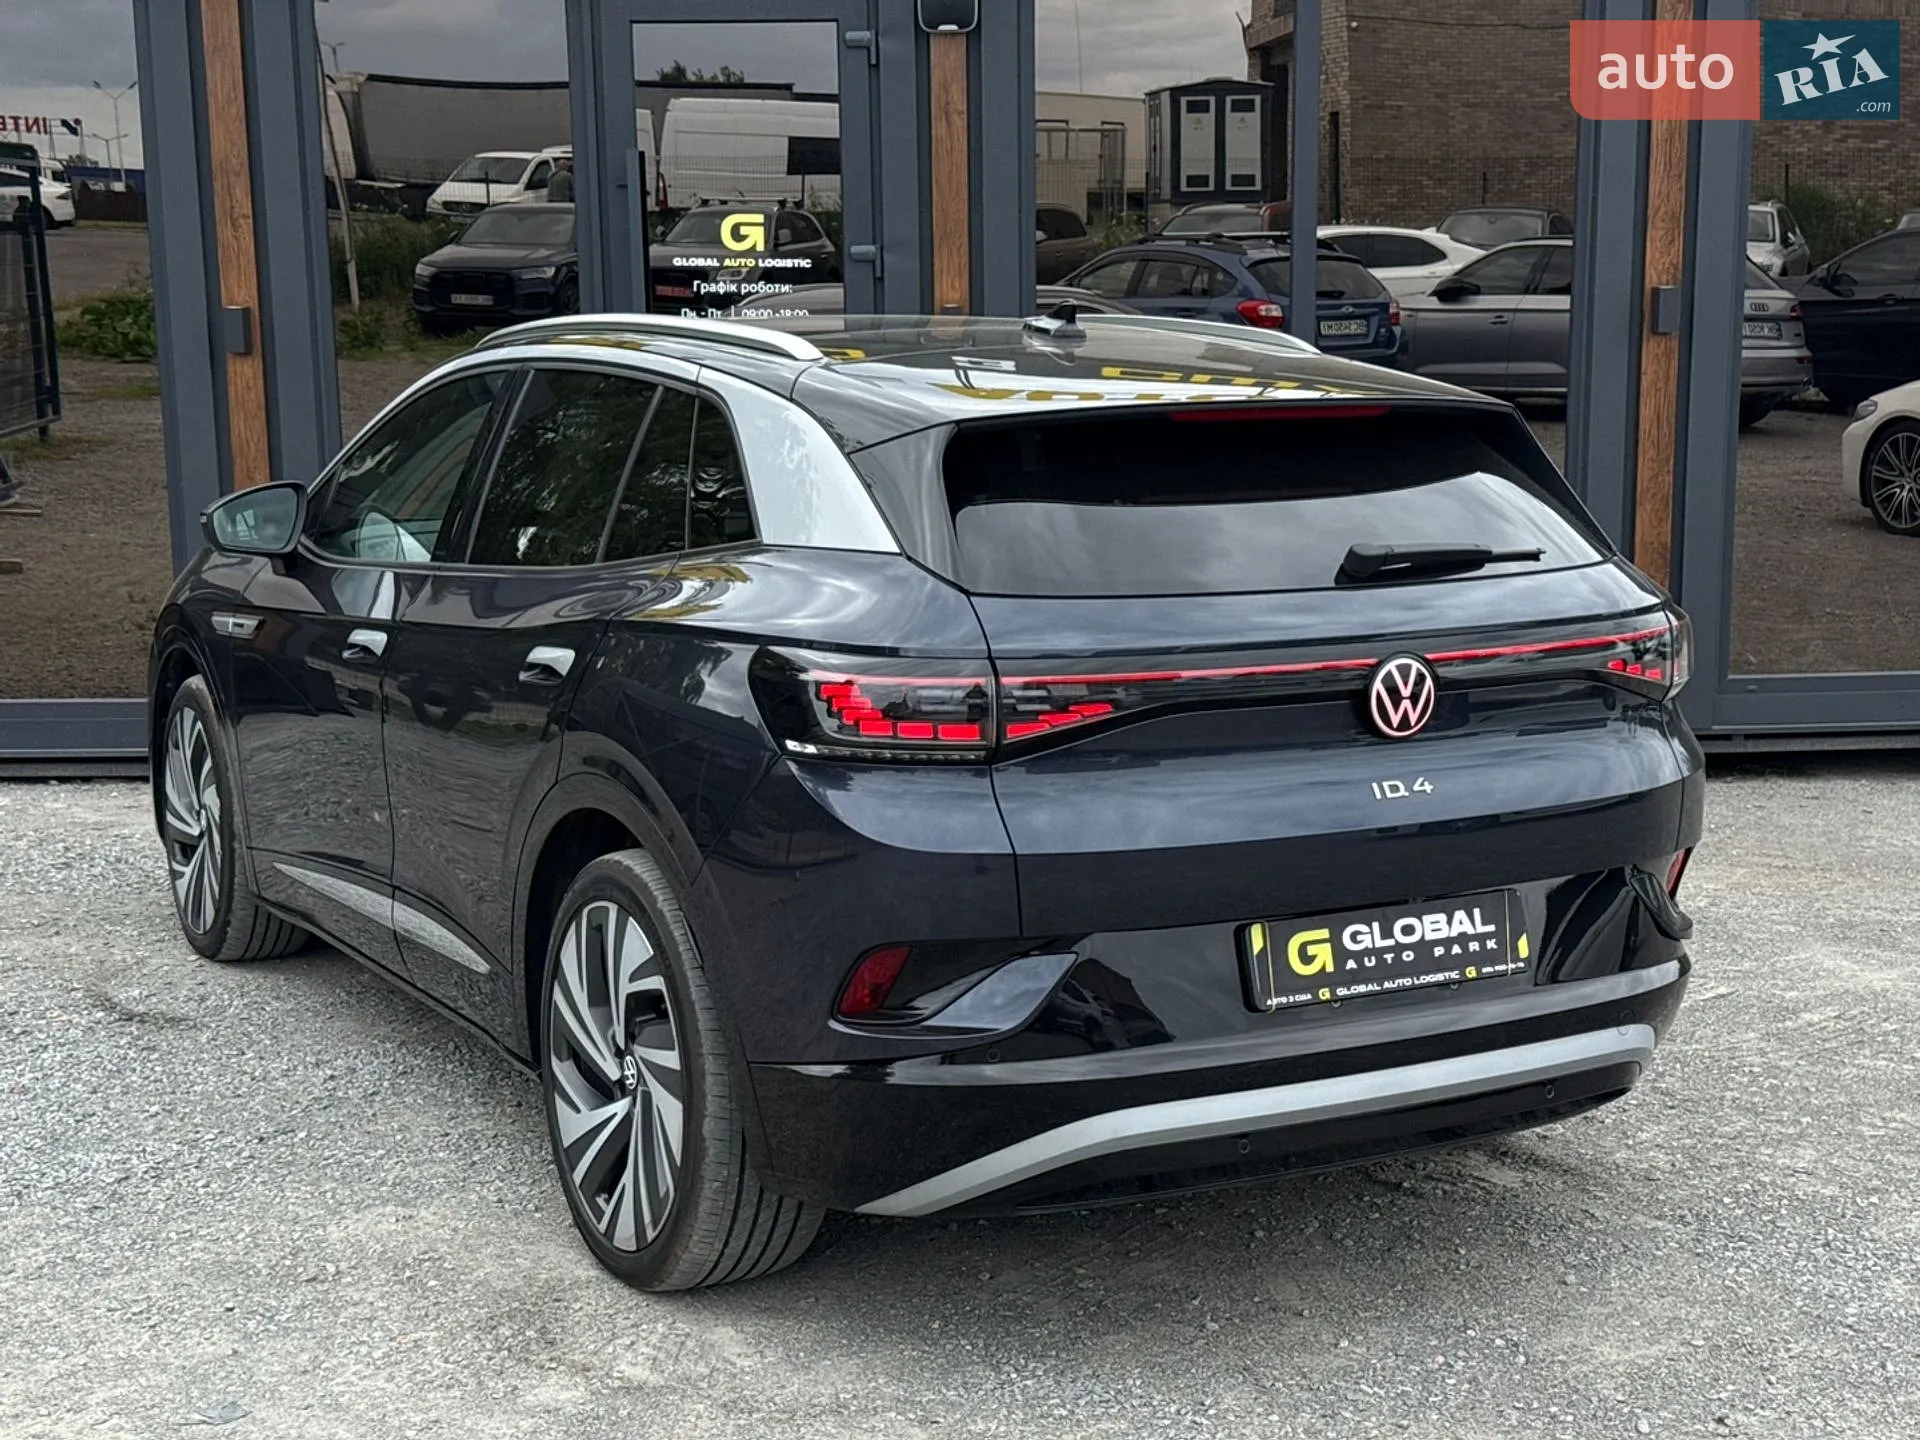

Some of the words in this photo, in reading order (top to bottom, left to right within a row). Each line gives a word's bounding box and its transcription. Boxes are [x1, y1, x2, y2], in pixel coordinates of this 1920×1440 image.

[672, 257, 720, 267] GLOBAL
[723, 258, 755, 267] AUTO
[758, 258, 812, 268] LOGISTIC
[693, 280, 738, 295] Графік
[741, 281, 793, 295] роботи:
[1342, 907, 1496, 951] GLOBAL
[1344, 951, 1415, 970] AUTO
[1434, 938, 1498, 957] PARK
[1336, 983, 1381, 997] GLOBAL
[1383, 977, 1412, 989] AUTO
[1413, 970, 1460, 985] LOGISTIC
